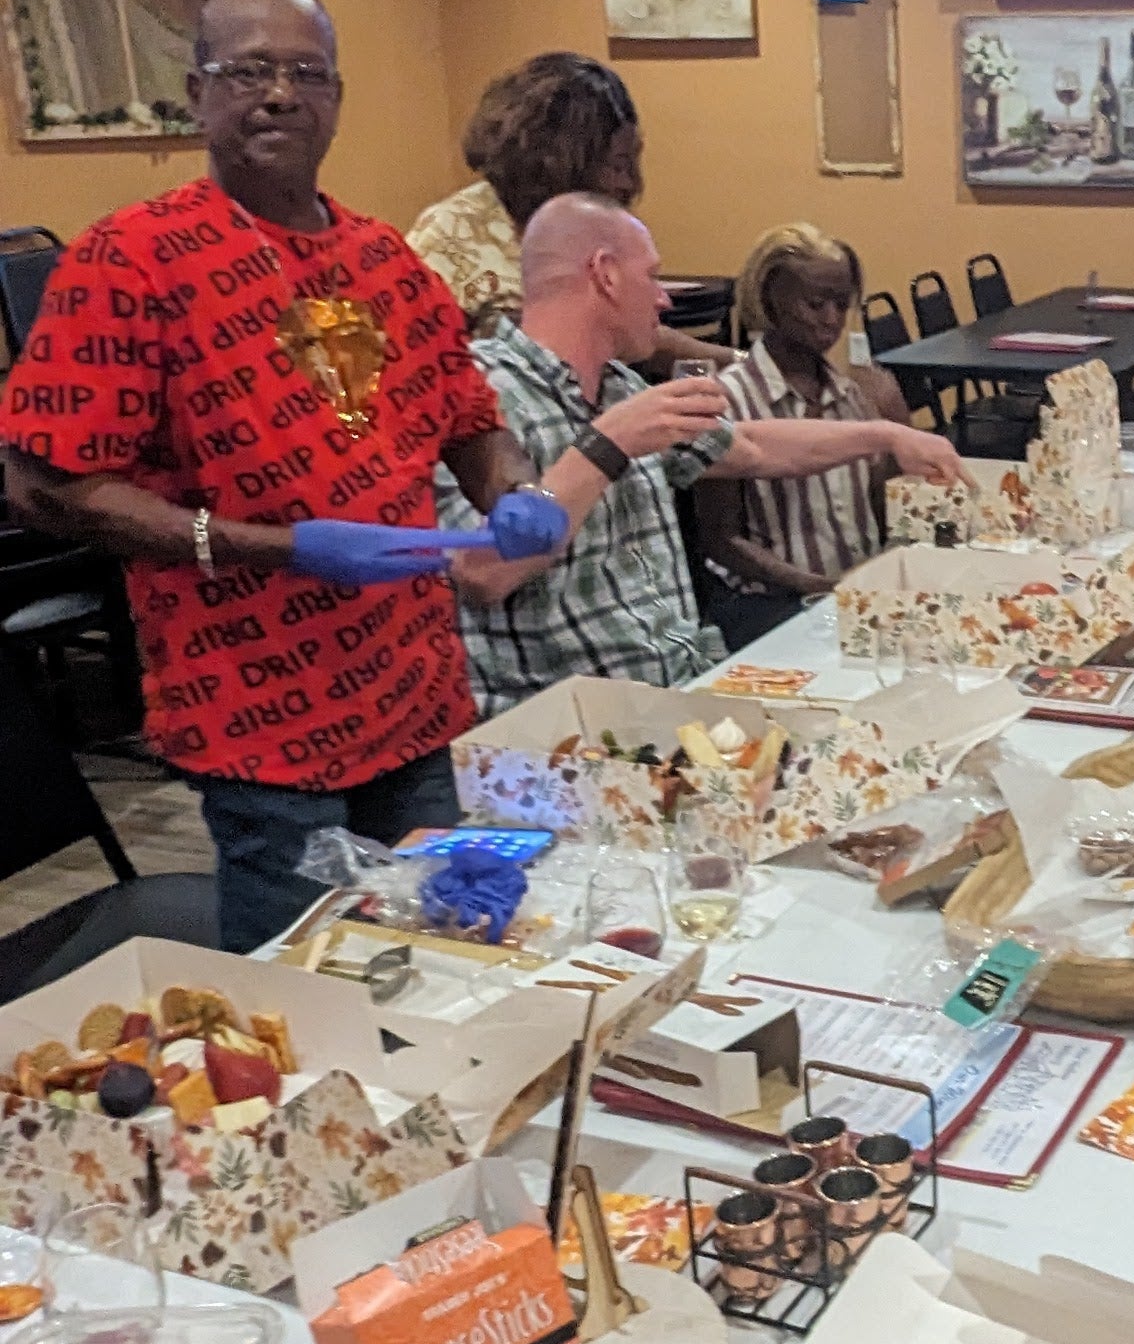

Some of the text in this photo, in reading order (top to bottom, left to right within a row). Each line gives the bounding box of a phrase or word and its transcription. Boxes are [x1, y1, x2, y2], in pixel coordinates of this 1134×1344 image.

[207, 245, 283, 296] DRIP
[10, 384, 95, 415] DRIP
[187, 365, 258, 417] DRIP
[234, 445, 315, 499] DRIP
[328, 453, 392, 507] DRIP
[183, 614, 267, 659] DRIP
[239, 639, 320, 688] DRIP
[326, 643, 395, 699] DRIP
[225, 687, 313, 737] DRIP
[280, 714, 365, 764] DRIP
